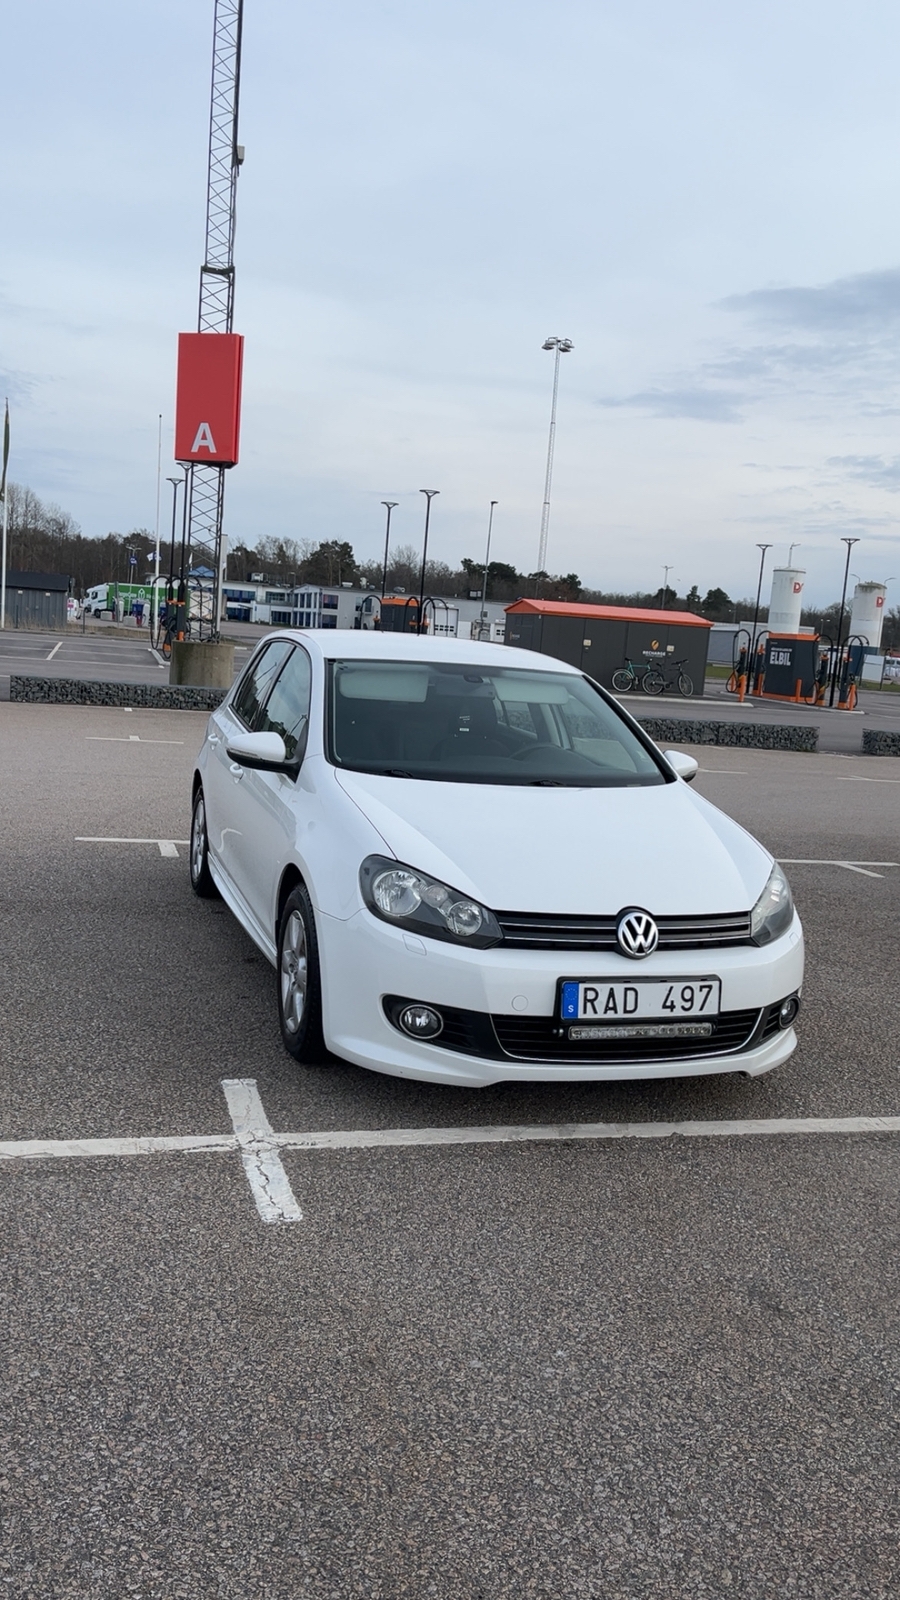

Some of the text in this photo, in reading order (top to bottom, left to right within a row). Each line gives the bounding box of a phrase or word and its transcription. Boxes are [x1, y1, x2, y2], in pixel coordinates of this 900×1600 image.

[190, 422, 217, 453] A
[769, 651, 791, 666] ELBIL
[567, 1004, 575, 1013] S
[582, 984, 714, 1015] RAD 497
